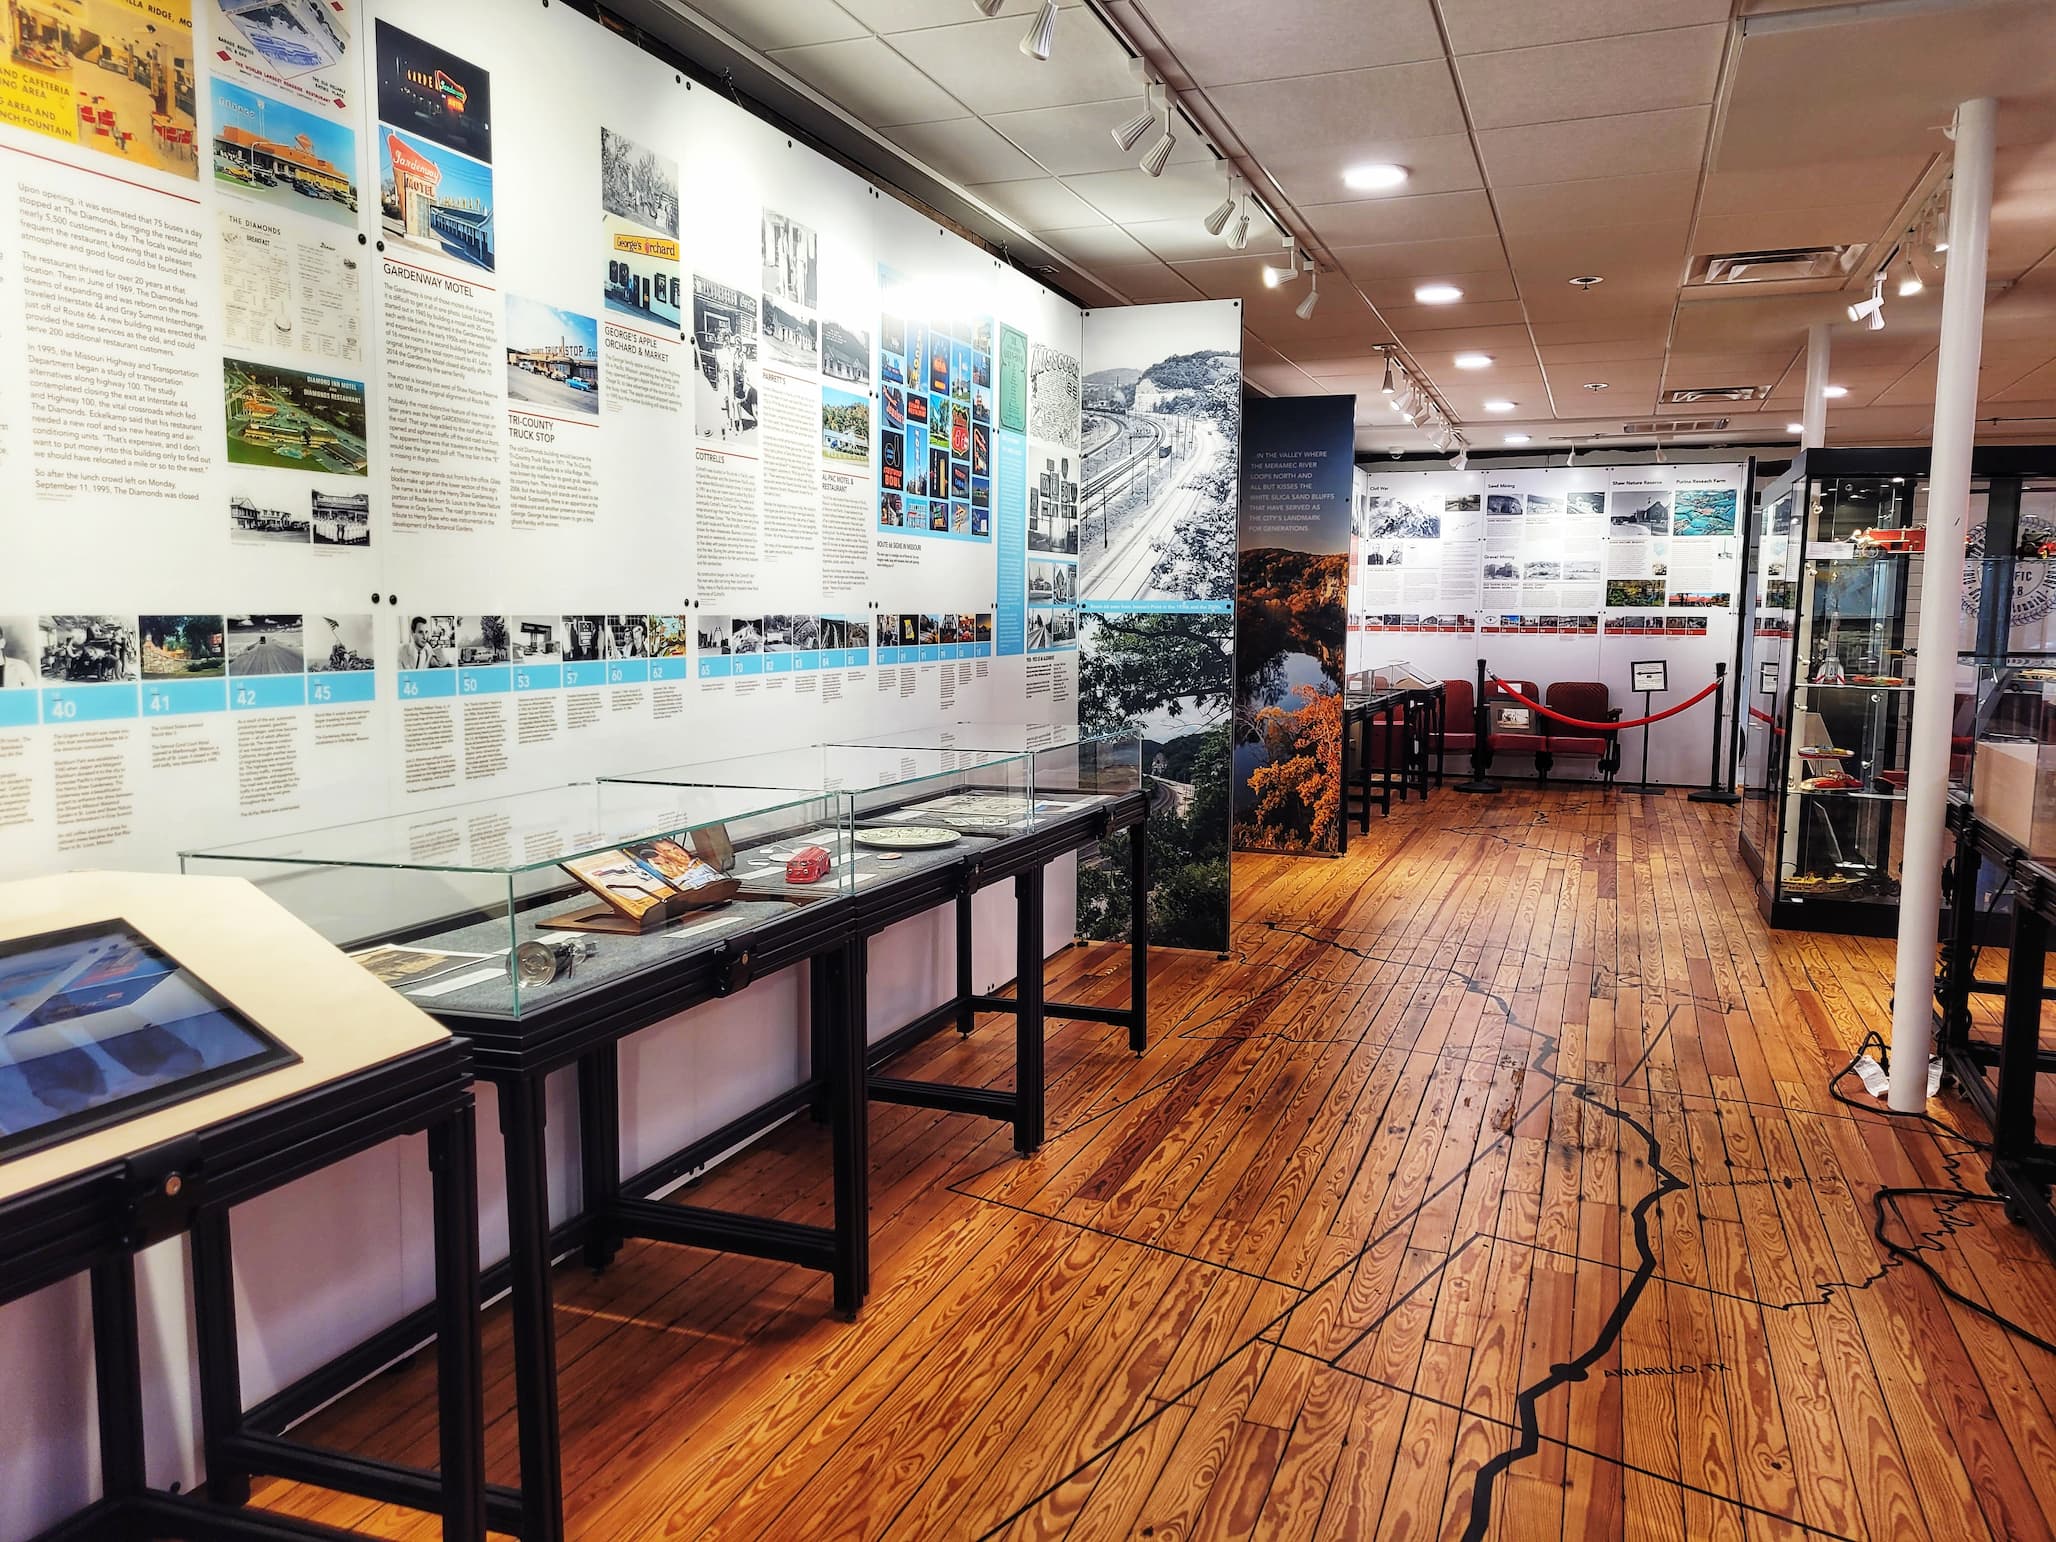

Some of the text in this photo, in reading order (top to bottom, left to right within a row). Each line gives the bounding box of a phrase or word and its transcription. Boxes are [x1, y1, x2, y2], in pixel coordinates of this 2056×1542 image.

[148, 4, 174, 22] RIDGE,
[179, 17, 192, 28] MO
[22, 75, 70, 96] CAFETERIA
[22, 85, 47, 98] AREA
[7, 99, 32, 113] AREA
[35, 108, 55, 120] AND
[23, 116, 72, 137] FOUNTAIN
[393, 150, 439, 180] Gardenway
[406, 177, 434, 197] MOTEL
[18, 182, 40, 199] Upon
[85, 202, 99, 211] was
[100, 203, 136, 221] estimated
[137, 213, 152, 224] that
[163, 220, 183, 233] buses
[190, 226, 202, 240] day
[230, 215, 281, 236] THE DIAMONDS
[617, 236, 642, 251] George's
[57, 270, 77, 282] Then
[86, 276, 104, 288] June
[135, 286, 149, 297] The
[150, 290, 184, 304] Diamonds
[185, 297, 197, 307] had
[384, 263, 474, 297] GARDENWAY MOTEL
[24, 286, 56, 301] traveled
[57, 293, 92, 308] Interstate
[104, 302, 118, 313] and
[119, 306, 137, 319] Gray
[137, 309, 164, 322] Summit
[165, 315, 203, 332] Interchange
[605, 326, 657, 348] GEORGE'S APPLE
[565, 345, 584, 357] STOP
[587, 348, 598, 358] Res
[605, 338, 636, 354] ORCHARD
[645, 349, 669, 362] MARKET
[59, 347, 72, 357] the
[74, 350, 104, 363] Missouri
[105, 355, 136, 370] Highway
[137, 360, 151, 370] and
[151, 363, 199, 380] Transportation
[30, 390, 45, 400] and
[47, 392, 79, 407] Highway
[98, 399, 110, 408] the
[111, 401, 126, 411] vital
[127, 403, 164, 416] crossroads
[164, 408, 184, 418] which
[185, 411, 196, 420] fed
[508, 414, 554, 431] TRI-COUNTY
[508, 427, 555, 443] TRUCK STOP
[46, 469, 64, 478] after
[66, 471, 78, 479] the
[80, 472, 100, 481] lunch
[100, 474, 123, 483] crowd
[124, 476, 136, 485] left
[611, 670, 623, 681] 60
[653, 668, 663, 678] 62
[735, 663, 743, 672] 70
[463, 679, 477, 691] 50
[518, 676, 530, 688] 53
[567, 673, 578, 685] 57
[237, 690, 256, 705] 42
[314, 685, 331, 700] 45
[403, 683, 418, 696] 46
[52, 701, 76, 719] 40
[151, 695, 169, 712] 41
[1703, 1363, 1732, 1372] TX
